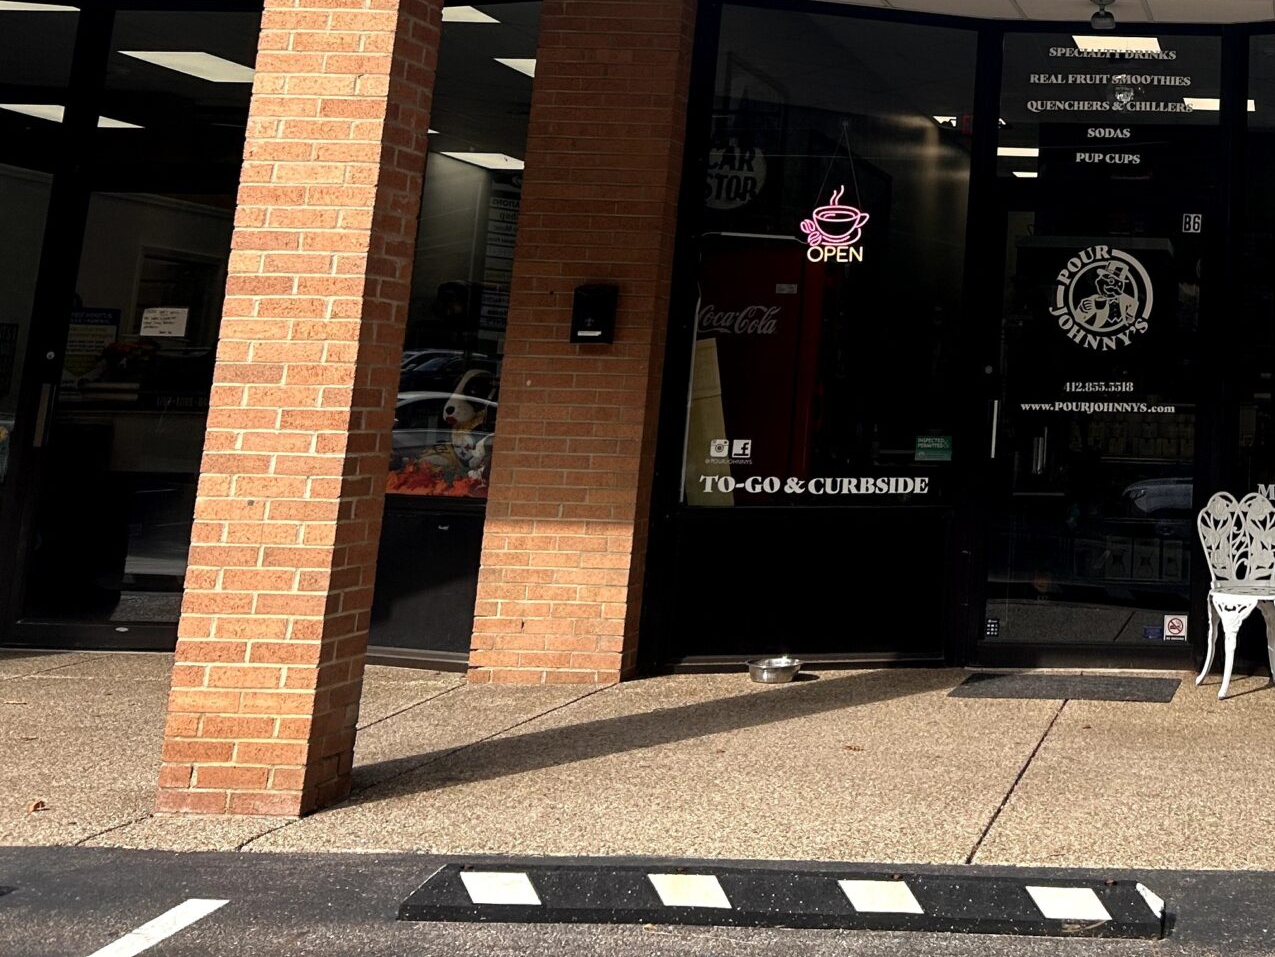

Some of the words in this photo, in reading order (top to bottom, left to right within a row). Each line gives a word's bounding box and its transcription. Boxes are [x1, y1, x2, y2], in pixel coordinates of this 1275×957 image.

[1048, 47, 1123, 59] SPECIALTY
[1124, 49, 1177, 60] DRINKS
[1030, 74, 1065, 84] REAL
[1067, 75, 1110, 84] FRUIT
[1111, 74, 1191, 86] SMOOTHIES
[1027, 100, 1109, 112] QUENCHERS
[1112, 101, 1124, 111] &
[1125, 101, 1194, 113] CHILLERS
[1087, 128, 1131, 138] SODAS
[1075, 152, 1104, 163] PUP
[1105, 154, 1141, 164] CUPS
[806, 246, 863, 263] OPEN
[1057, 245, 1111, 286] POUR
[1049, 306, 1149, 351] JOHNNY'S
[1020, 401, 1176, 414] www.POURJOHNNYS.com
[699, 475, 781, 494] TO-GO
[783, 477, 806, 494] &
[808, 477, 930, 495] CURBSIDE
